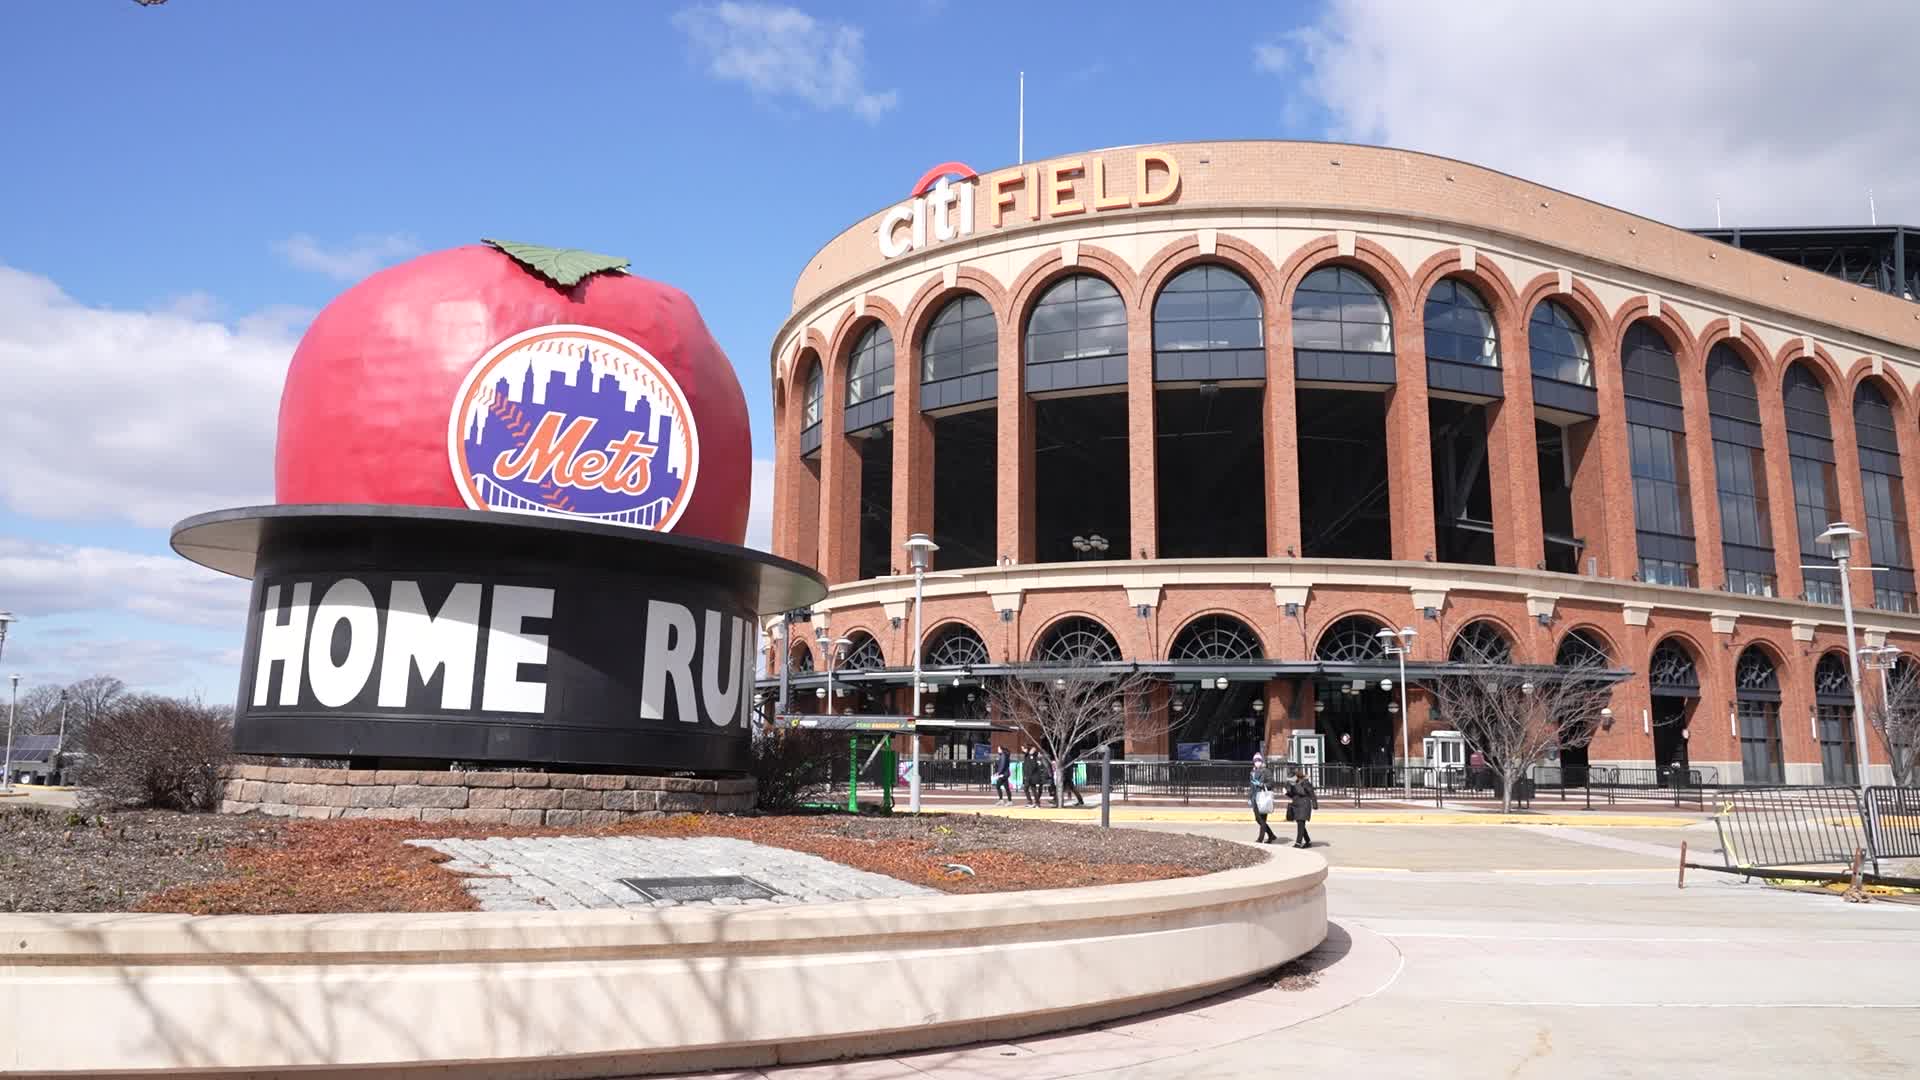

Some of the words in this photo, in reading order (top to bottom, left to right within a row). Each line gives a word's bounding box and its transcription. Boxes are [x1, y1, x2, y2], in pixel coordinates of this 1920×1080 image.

[878, 175, 976, 259] citi
[991, 151, 1182, 228] FIELD
[494, 411, 658, 496] Mets
[253, 578, 556, 714] HOME
